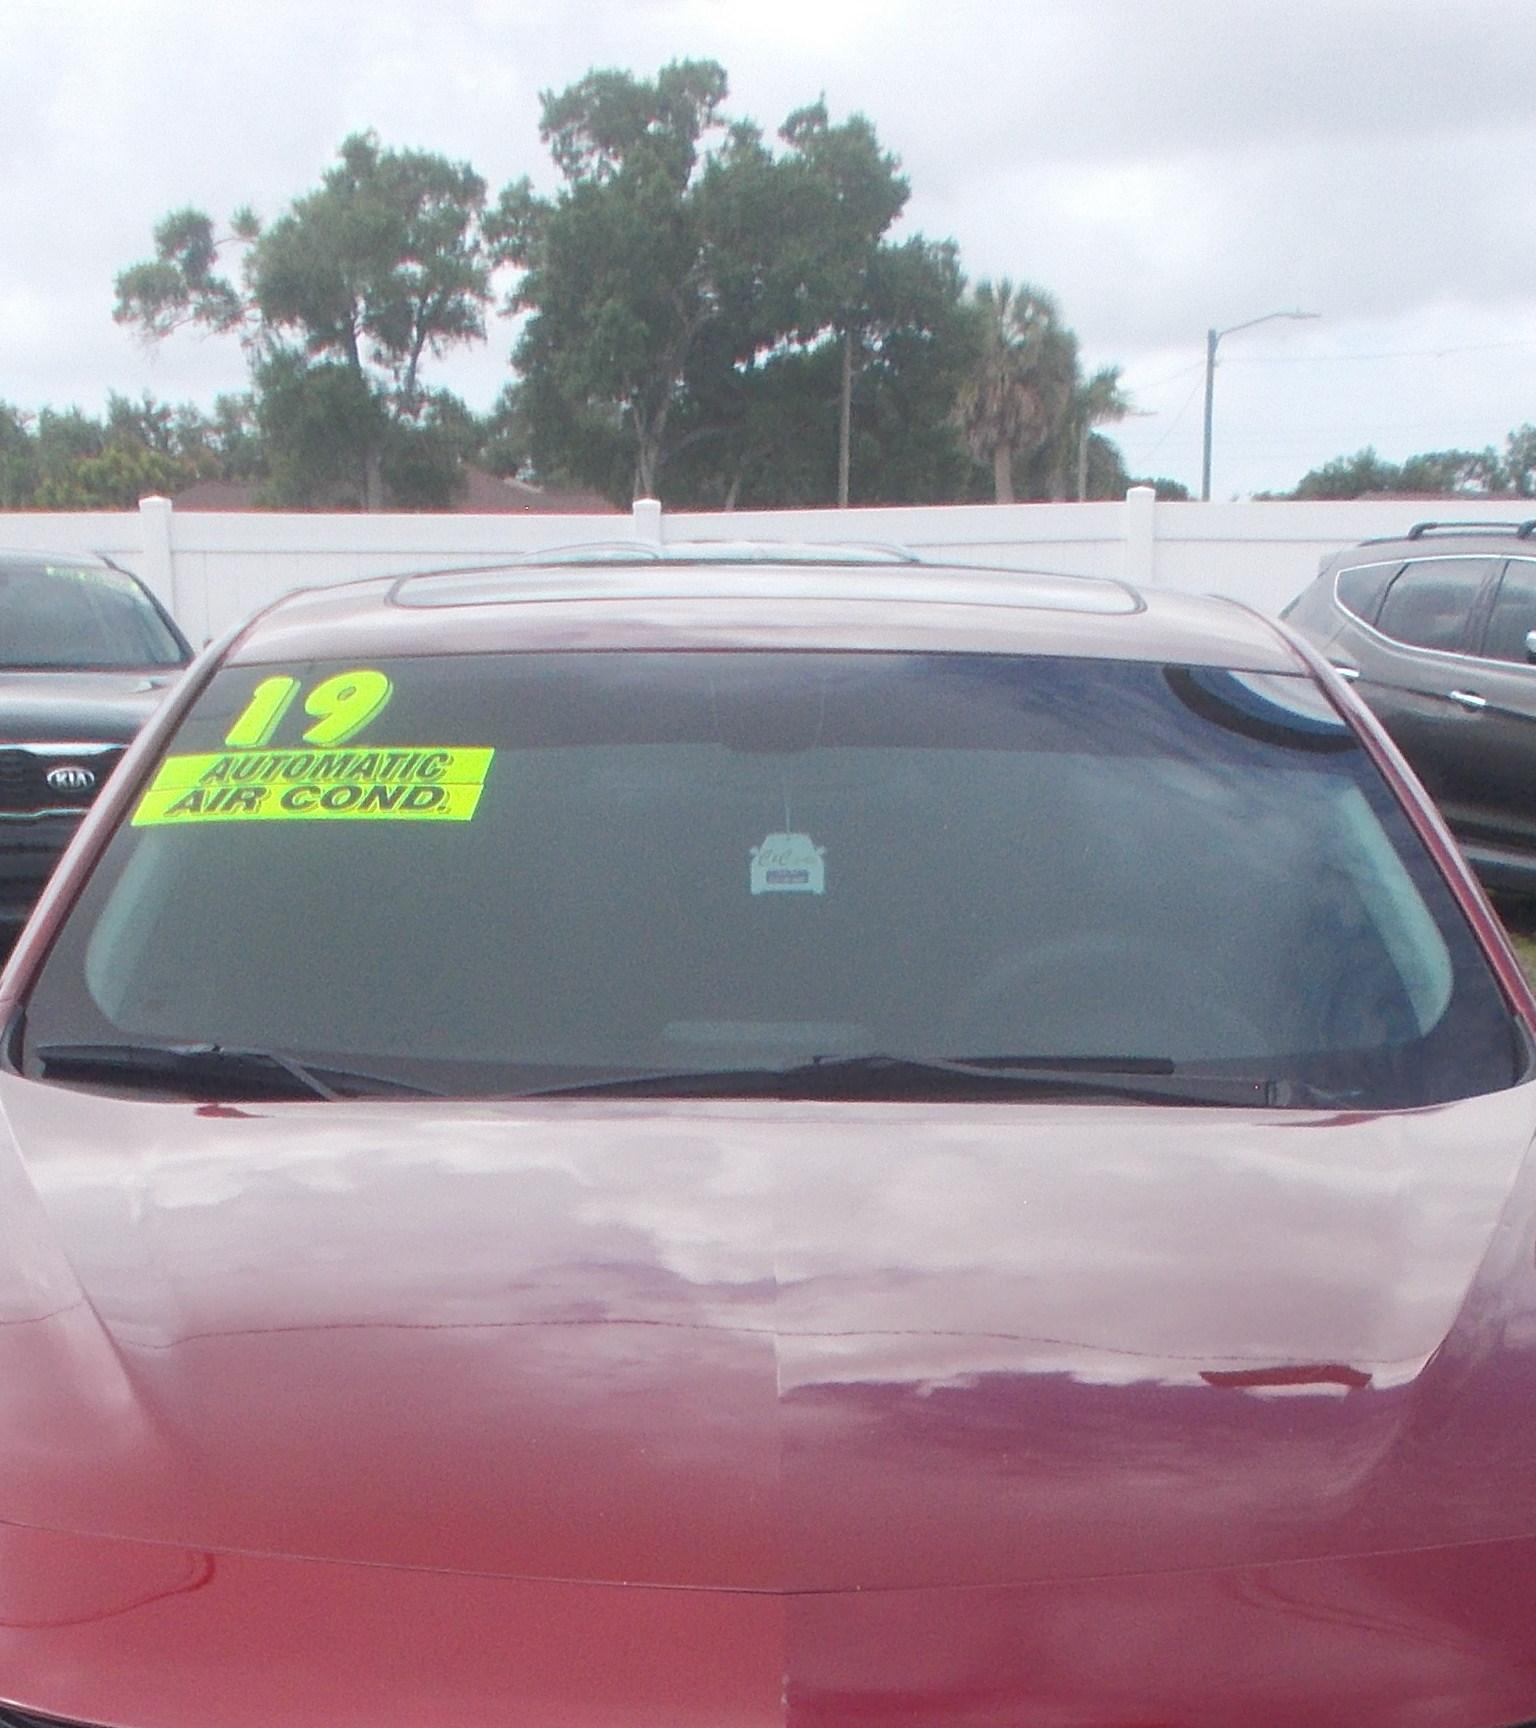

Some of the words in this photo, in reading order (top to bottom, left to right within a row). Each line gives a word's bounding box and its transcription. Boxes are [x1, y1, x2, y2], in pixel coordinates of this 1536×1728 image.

[225, 670, 394, 747] 19
[199, 752, 455, 785] AUTOMATIC
[164, 785, 272, 818] AIR
[279, 784, 453, 815] COND.
